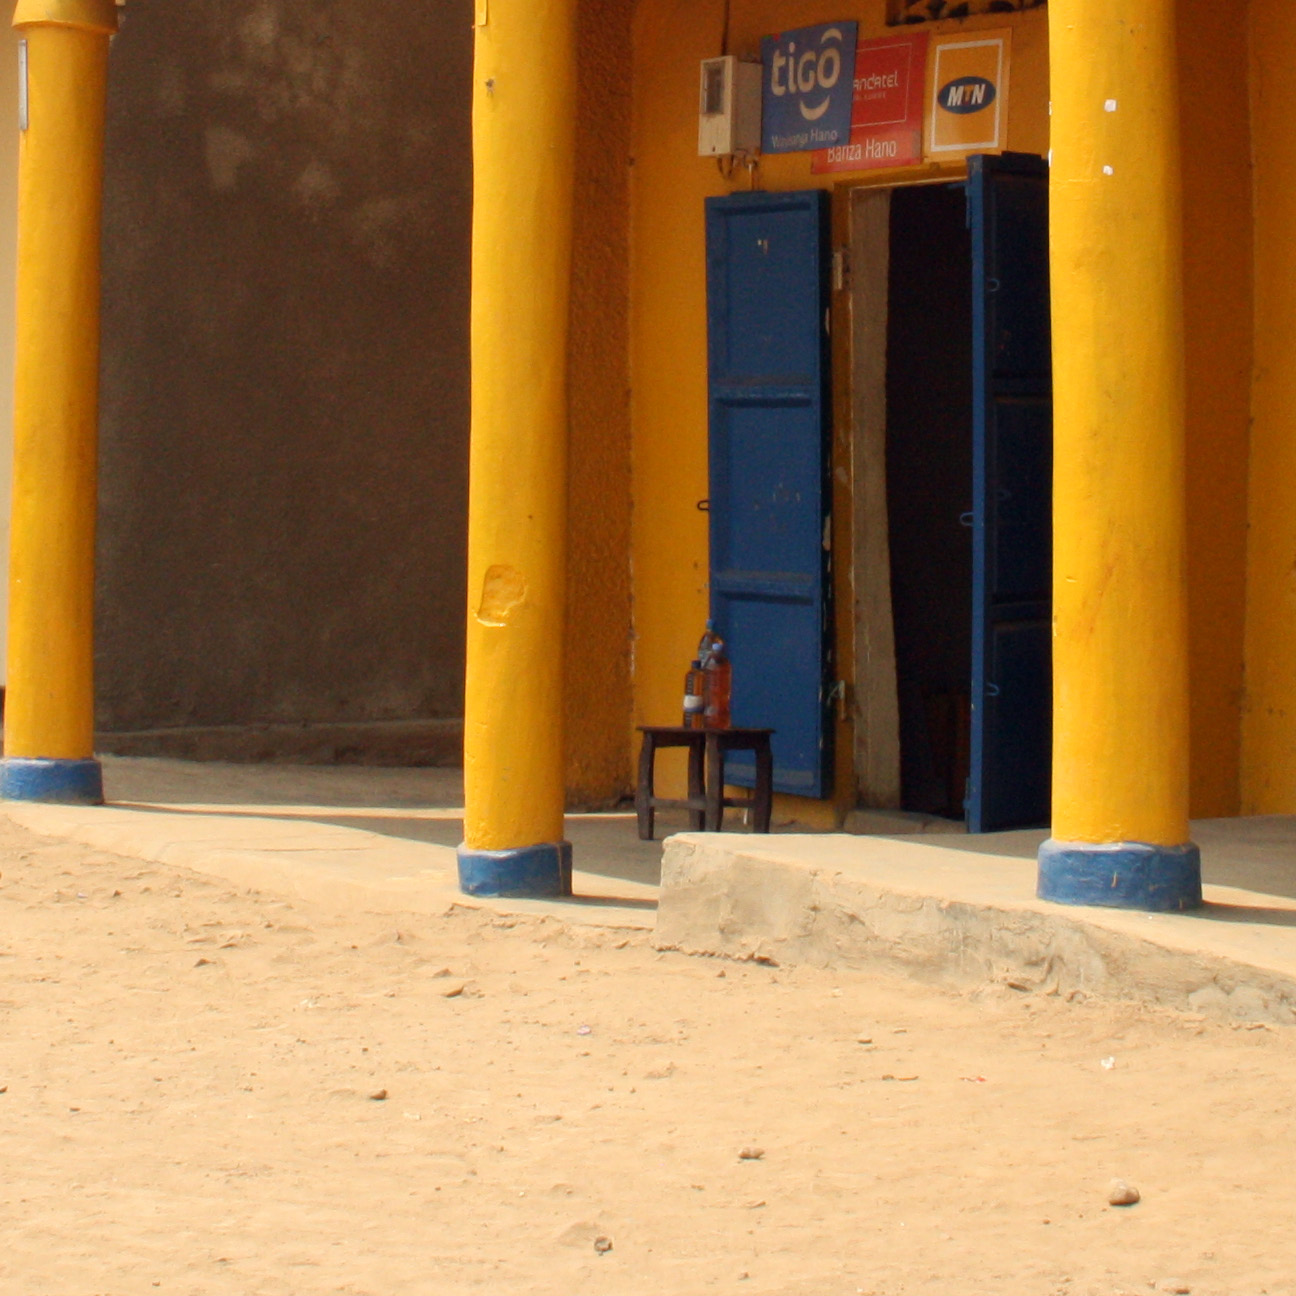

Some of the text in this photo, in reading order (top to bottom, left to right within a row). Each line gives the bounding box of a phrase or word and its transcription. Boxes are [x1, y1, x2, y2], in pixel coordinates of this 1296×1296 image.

[853, 70, 899, 91] andatel
[946, 83, 986, 107] MTN
[810, 127, 838, 142] Hano
[865, 138, 897, 159] Hano
